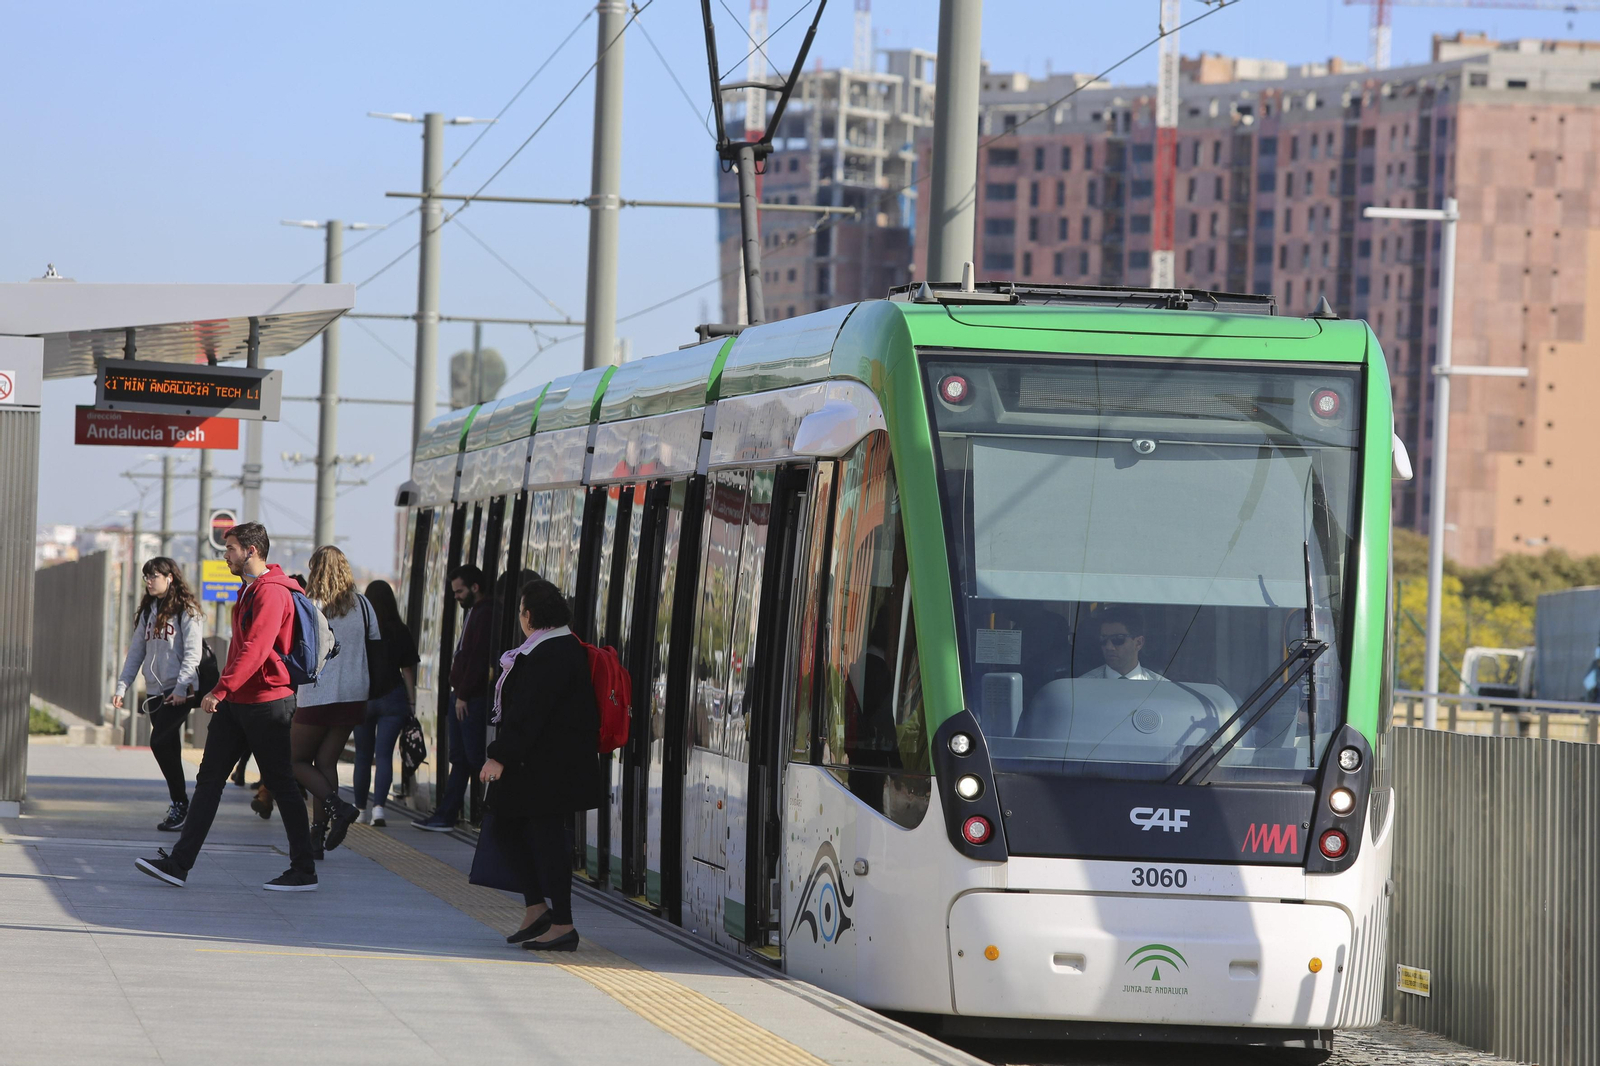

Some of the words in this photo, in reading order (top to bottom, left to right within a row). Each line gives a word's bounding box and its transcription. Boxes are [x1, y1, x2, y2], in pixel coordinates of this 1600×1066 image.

[123, 382, 145, 392] MIN
[215, 386, 242, 398] TECH
[86, 411, 122, 421] dirección
[86, 423, 164, 440] Andalucía
[168, 426, 205, 442] Tech
[1129, 807, 1191, 833] CAF
[1131, 867, 1188, 888] 3060
[1122, 985, 1142, 993] JUNTA
